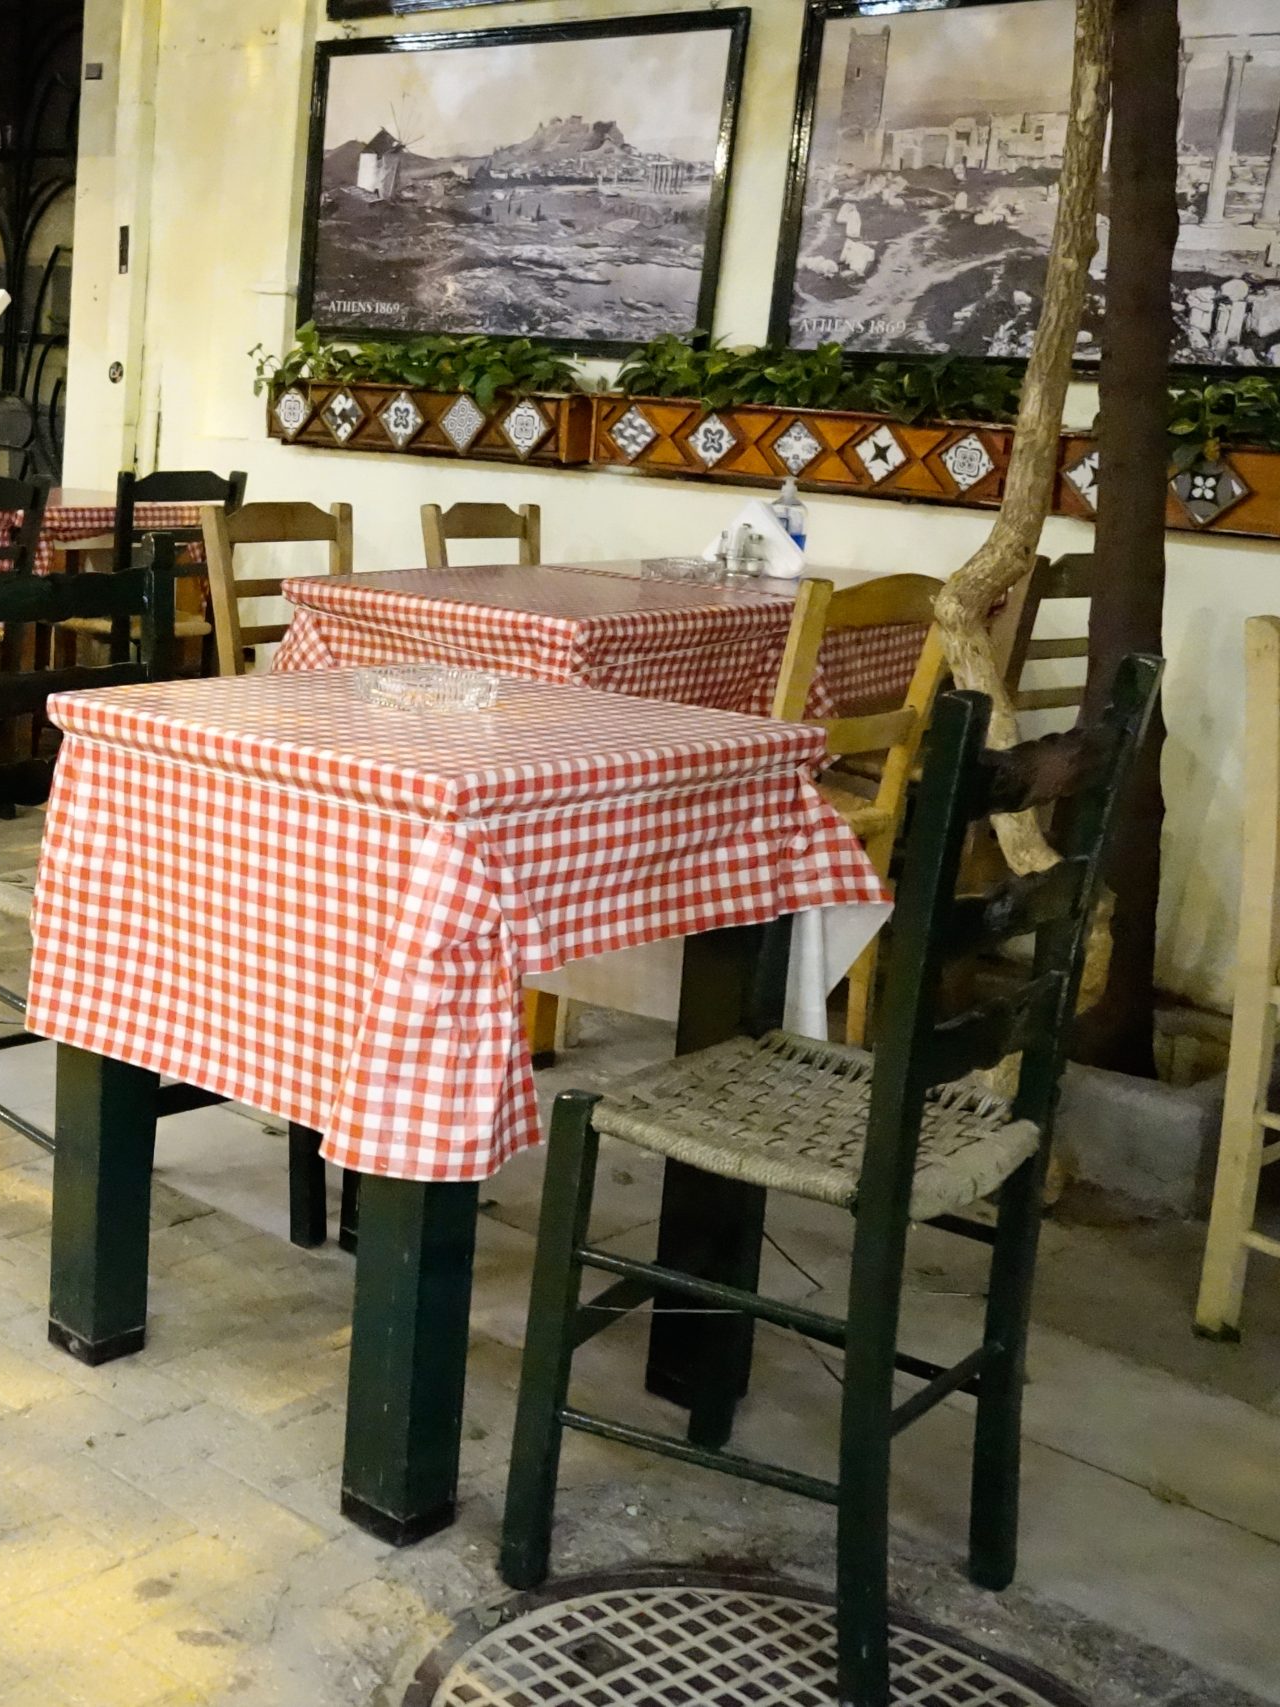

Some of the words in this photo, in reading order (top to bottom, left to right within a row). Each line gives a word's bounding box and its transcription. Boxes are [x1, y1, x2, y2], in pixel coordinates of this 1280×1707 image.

[328, 300, 373, 313] ATHENS
[374, 302, 400, 314] 1869
[800, 318, 865, 333] ATHENS
[869, 320, 906, 334] 1869
